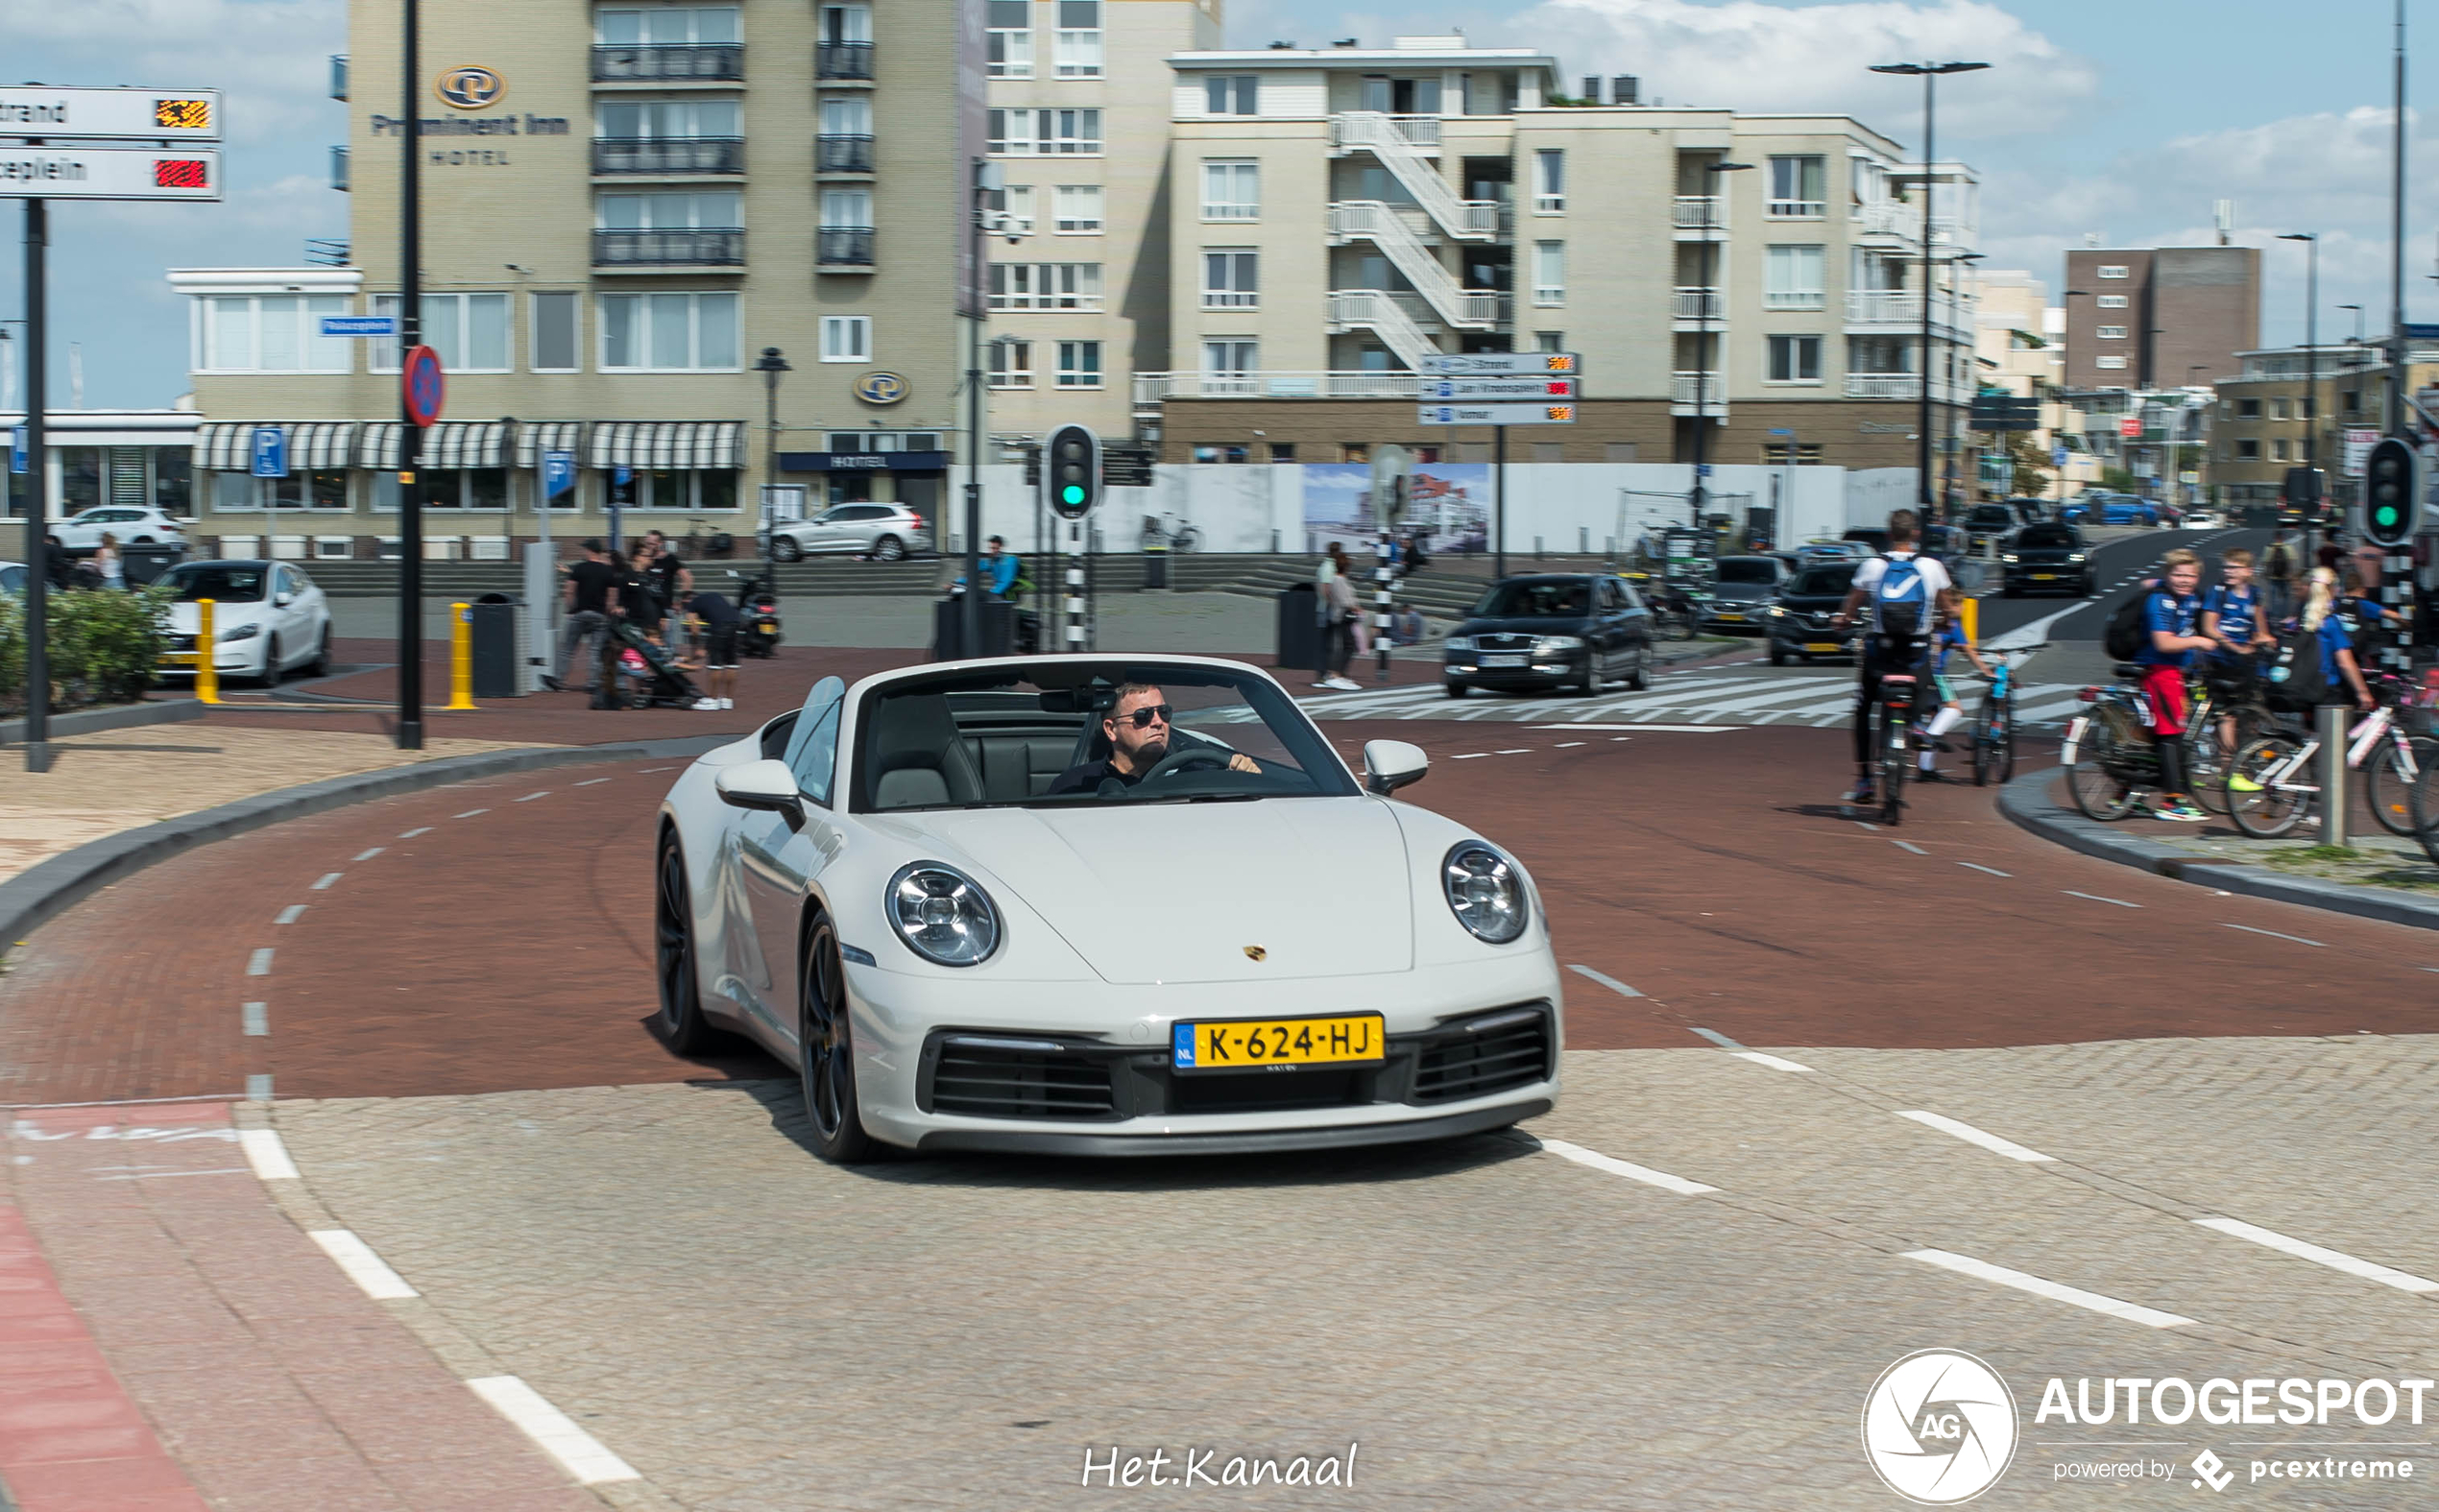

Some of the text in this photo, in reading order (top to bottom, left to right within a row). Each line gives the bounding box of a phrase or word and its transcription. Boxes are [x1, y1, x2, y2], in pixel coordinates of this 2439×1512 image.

[370, 113, 519, 136] Prminent
[430, 150, 511, 165] HOTEL
[831, 456, 888, 468] HOTEL
[1178, 1022, 1368, 1061] NL K-624-HJ
